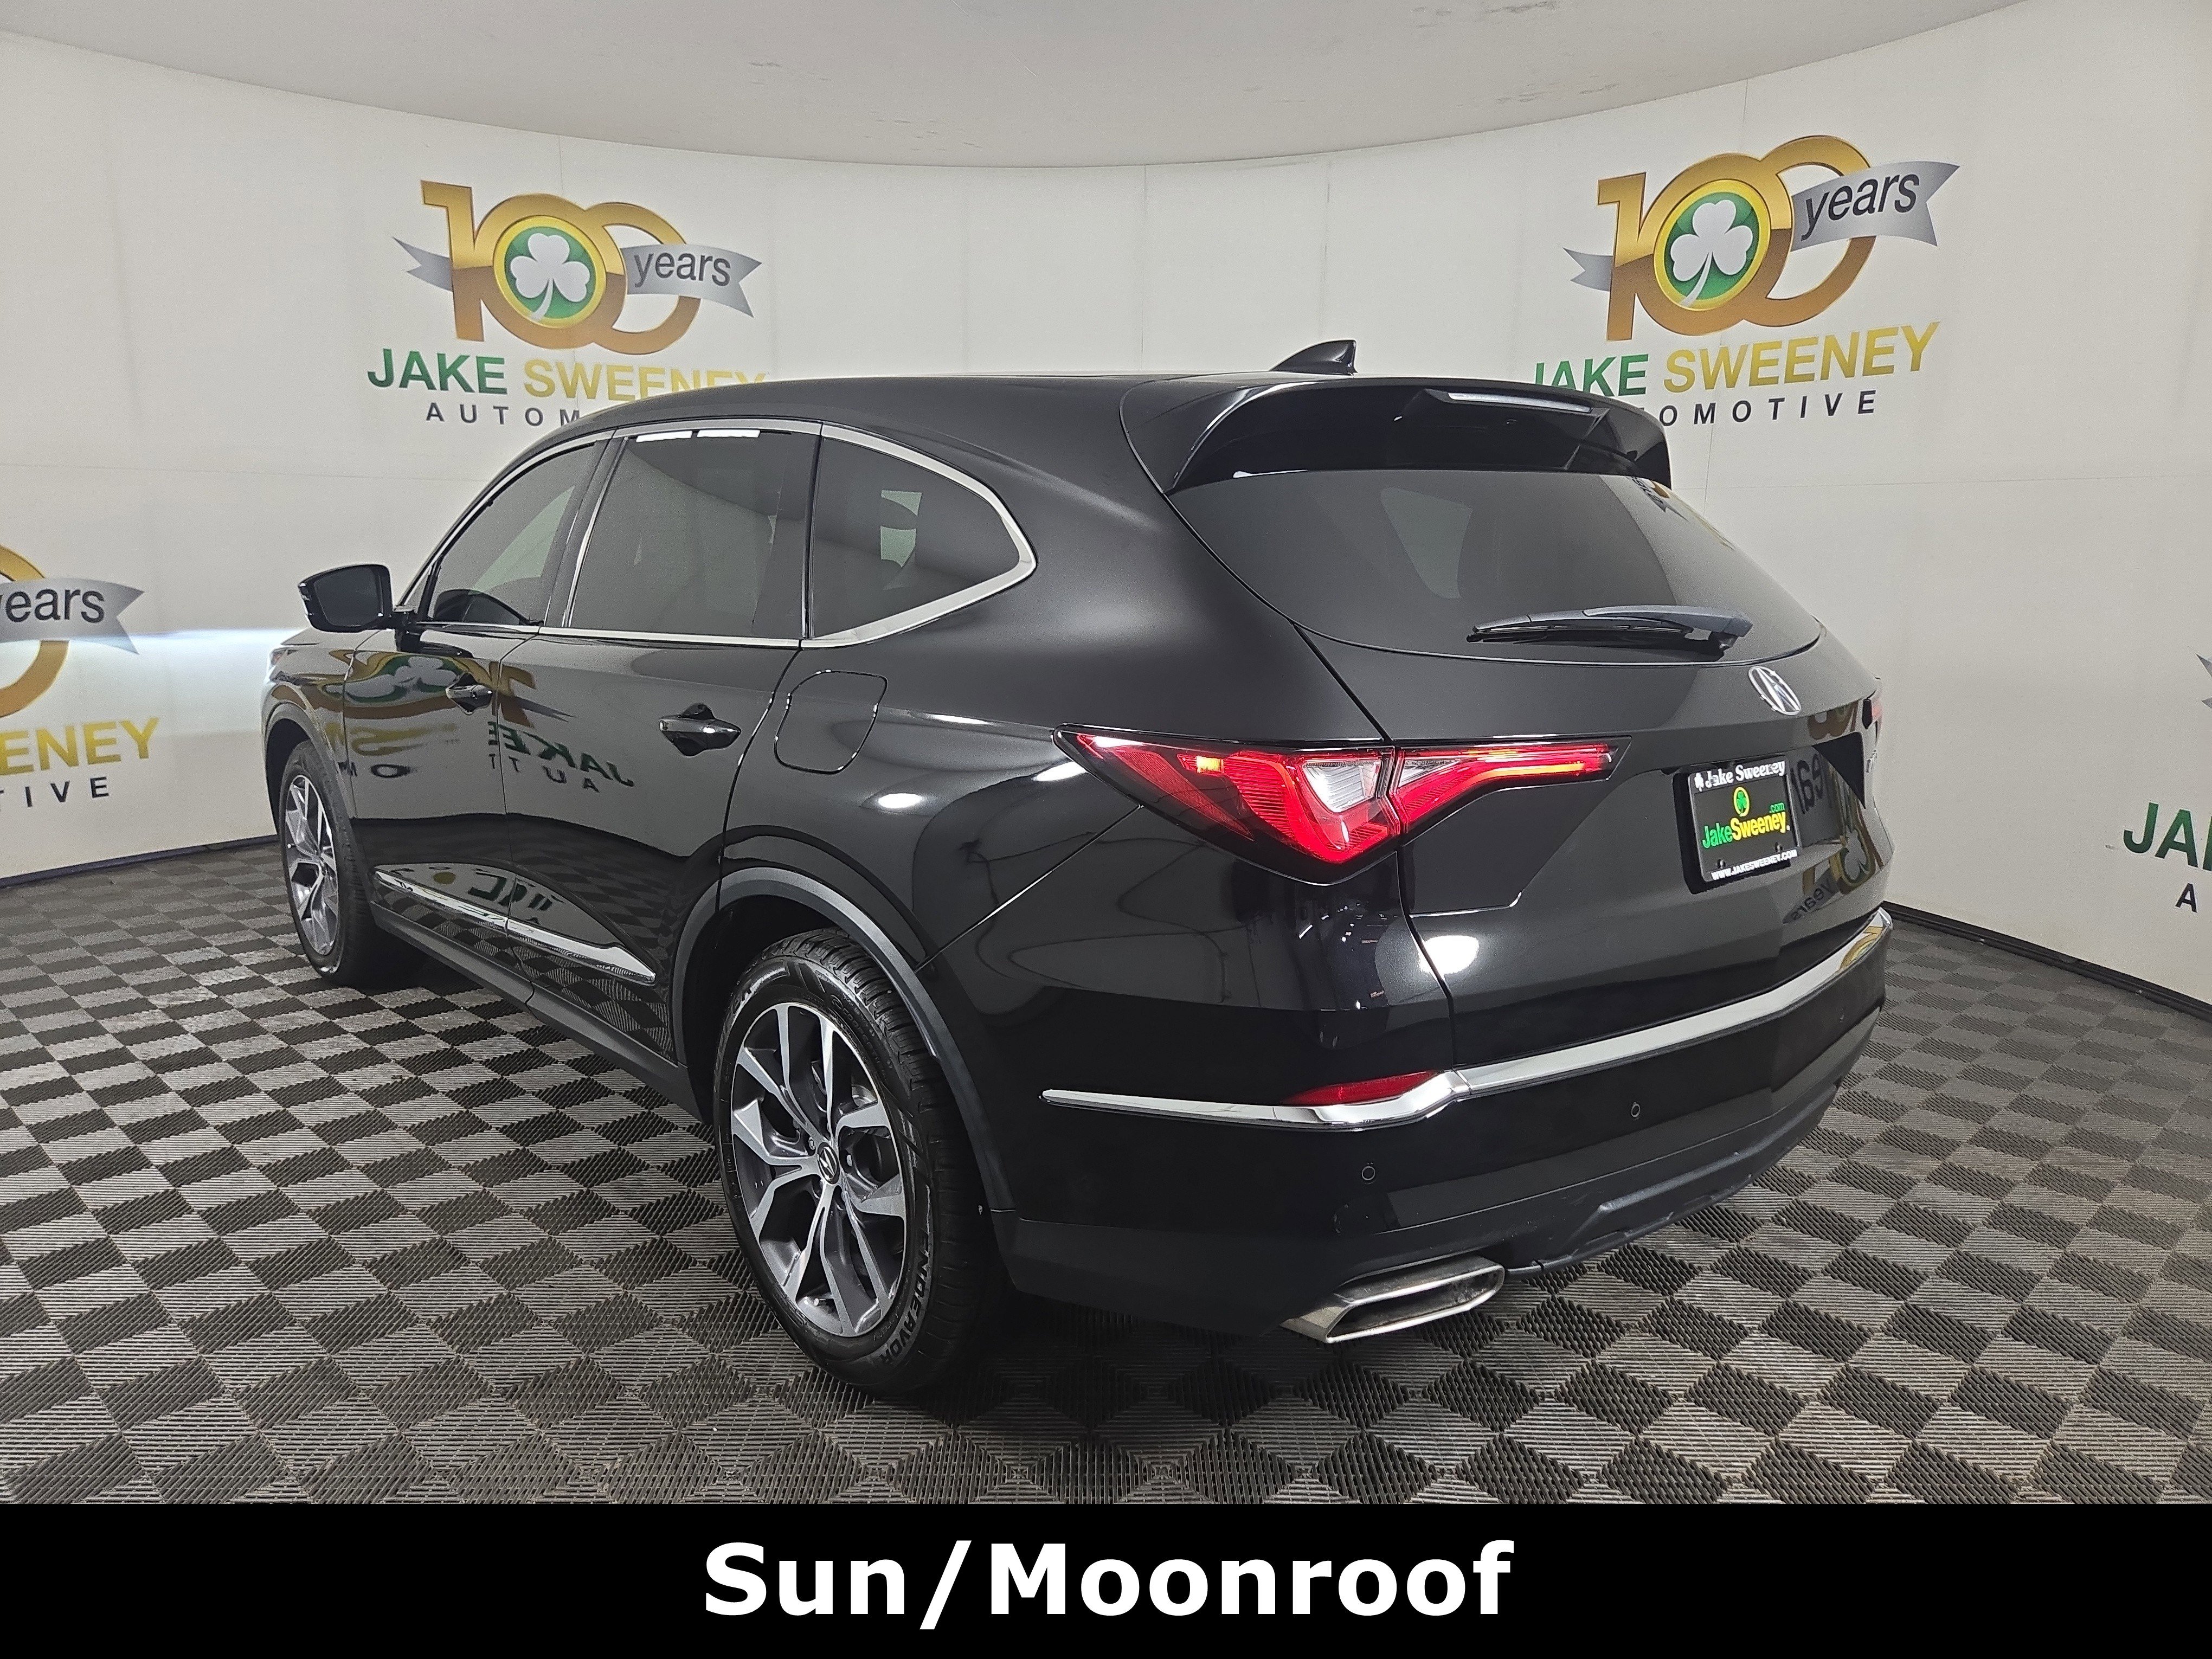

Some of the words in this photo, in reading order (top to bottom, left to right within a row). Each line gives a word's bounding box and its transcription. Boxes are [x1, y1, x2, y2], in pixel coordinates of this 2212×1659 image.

[1801, 173, 1920, 241] years
[1598, 135, 1876, 342] 100
[421, 180, 702, 355] 100
[634, 250, 731, 288] years
[367, 348, 507, 395] JAKE
[524, 359, 767, 402] SWEEN
[1663, 321, 1940, 393] SWEENEY
[426, 401, 580, 427] AUTOM
[1658, 390, 1876, 427] OMOTIVE
[0, 586, 105, 623] ears
[0, 717, 159, 776] ENEY
[1705, 768, 1734, 788] Jake
[1735, 761, 1785, 781] Sweeney
[1711, 849, 1798, 880] WWW.JAKESWEENEY.COM
[2123, 801, 2212, 872] JA
[879, 1232, 930, 1365] ENDEAVOR
